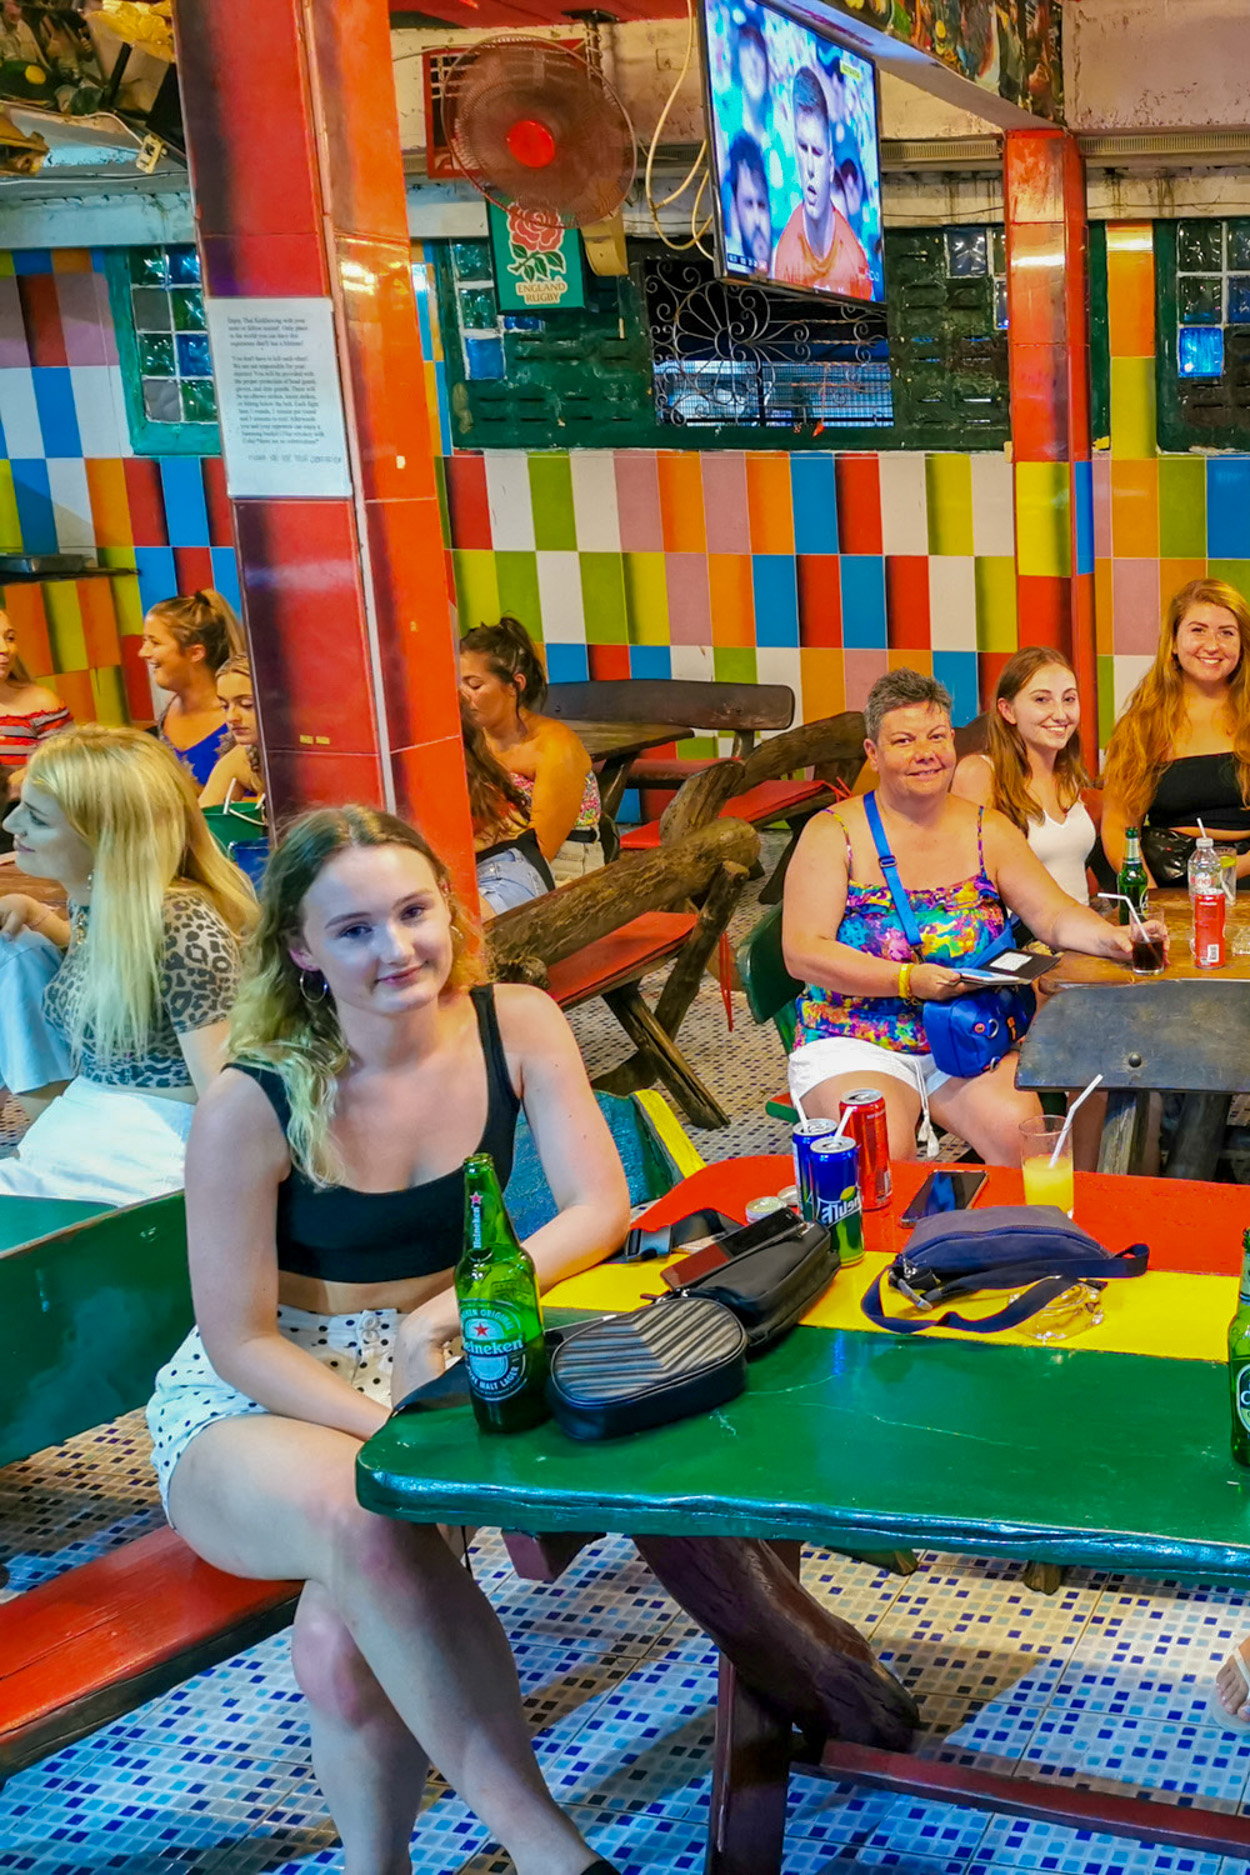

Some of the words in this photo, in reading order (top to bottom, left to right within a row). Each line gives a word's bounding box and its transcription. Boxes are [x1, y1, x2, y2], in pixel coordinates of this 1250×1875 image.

[518, 282, 566, 293] ENGLAND
[526, 293, 560, 303] RUGBY
[463, 1339, 524, 1355] eineken
